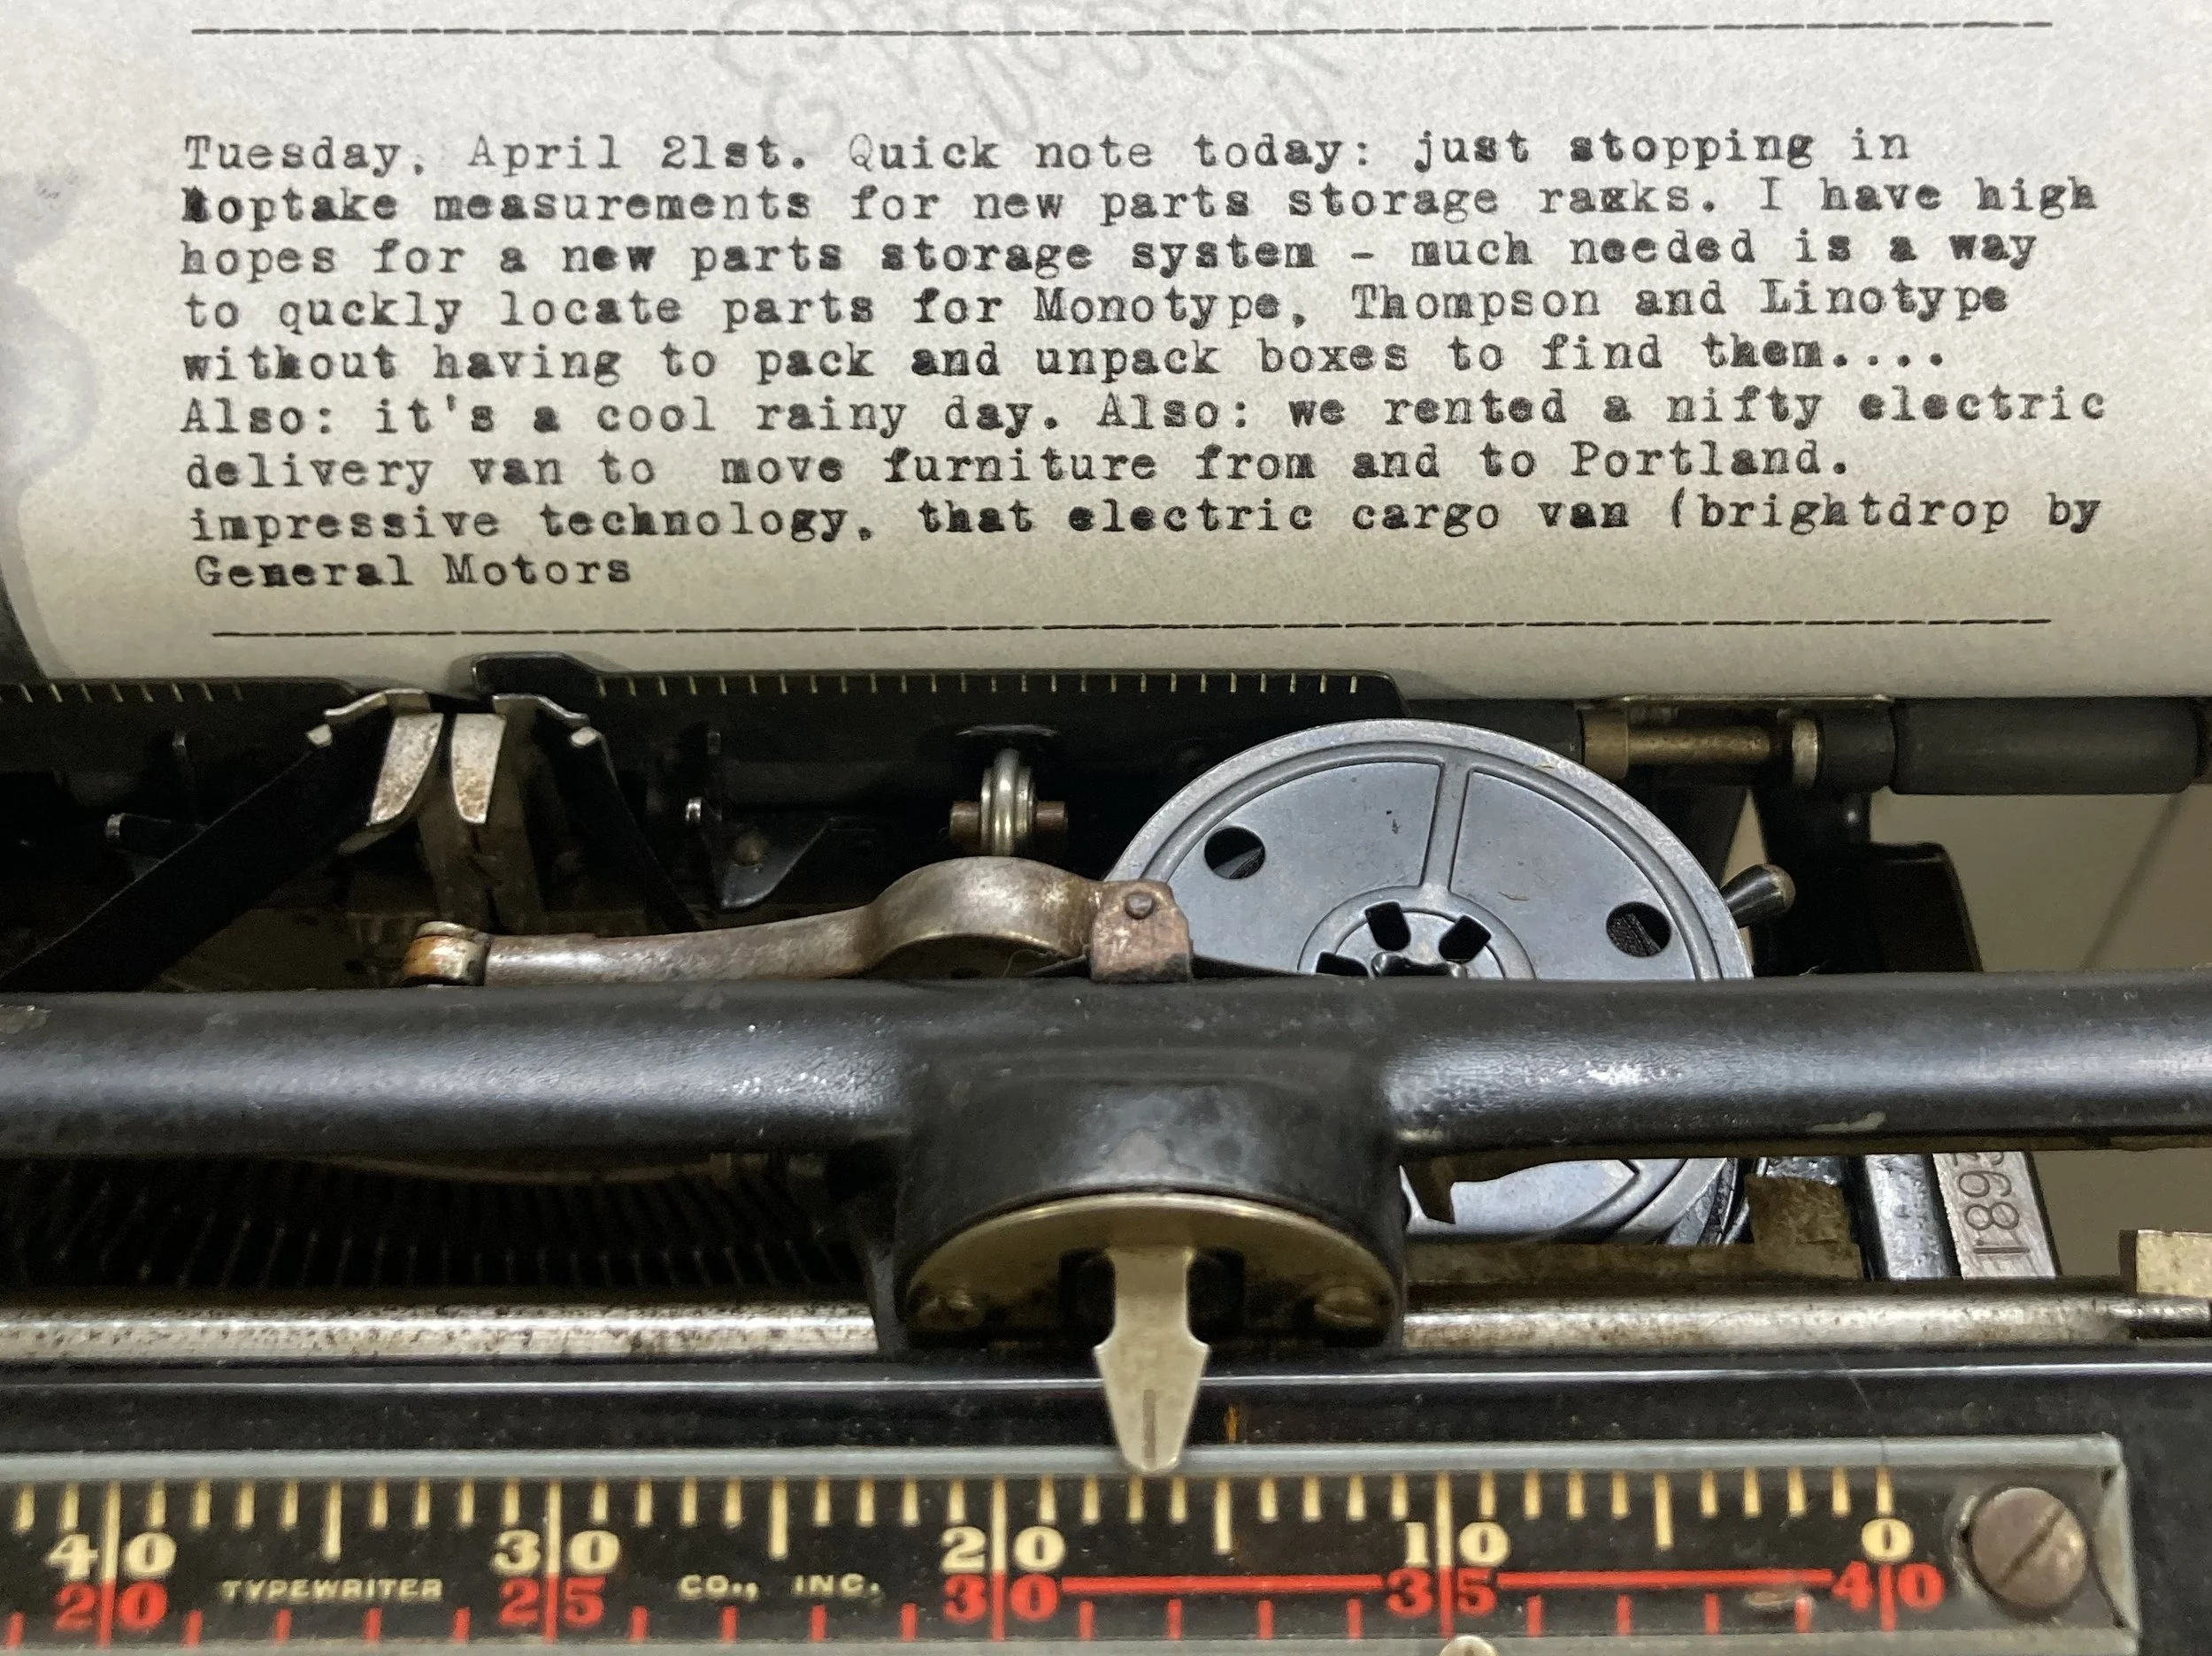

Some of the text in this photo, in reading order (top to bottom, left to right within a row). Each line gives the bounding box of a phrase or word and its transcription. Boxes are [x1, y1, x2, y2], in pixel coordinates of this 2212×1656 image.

[468, 134, 621, 177] April
[662, 134, 805, 169] 21st.
[849, 134, 1001, 172] Quick
[1035, 134, 1152, 169] note
[1194, 133, 1368, 174] today:
[1414, 130, 1529, 173] just
[1571, 127, 1815, 171] stopping
[1852, 127, 1910, 160] in
[434, 186, 810, 221] measurements
[851, 184, 940, 220] for
[974, 193, 1064, 219] new
[1100, 184, 1249, 226] parts
[1289, 182, 1499, 224] storage
[1759, 176, 1782, 211] I
[1819, 177, 1941, 211] have
[1975, 176, 2097, 219] high
[180, 240, 335, 284] hopes
[373, 238, 465, 274] for
[500, 247, 527, 273] a
[562, 246, 656, 272] new
[691, 236, 842, 281] parts
[881, 237, 1092, 280] storage
[1133, 234, 1318, 279] system
[1411, 230, 1533, 266] much
[1570, 228, 1755, 264] needed
[1795, 227, 1852, 263] is
[1889, 235, 1918, 263] a
[1948, 234, 2037, 271] way
[185, 278, 2008, 335] to quckly locate parts for Monotype, Thompson and Linotype
[183, 343, 396, 381] without
[434, 343, 621, 387] having
[660, 341, 717, 377] to
[756, 341, 875, 386] pack
[911, 341, 1002, 377] and
[1036, 340, 1221, 384] unpack
[1256, 337, 1408, 373] boxes
[1448, 335, 1504, 372] to
[1542, 333, 1663, 370] find
[180, 384, 2104, 439] Also: it's a cool rainy day. Also: we rented a nifty electric
[187, 439, 1847, 495] delivery van to move furniture from and to Portland.
[190, 487, 2101, 548] impressive technology, that electric cargo van (brightdrop by
[195, 553, 630, 587] General Motors
[218, 1572, 882, 1604] TYPEWRITER CO., INC.
